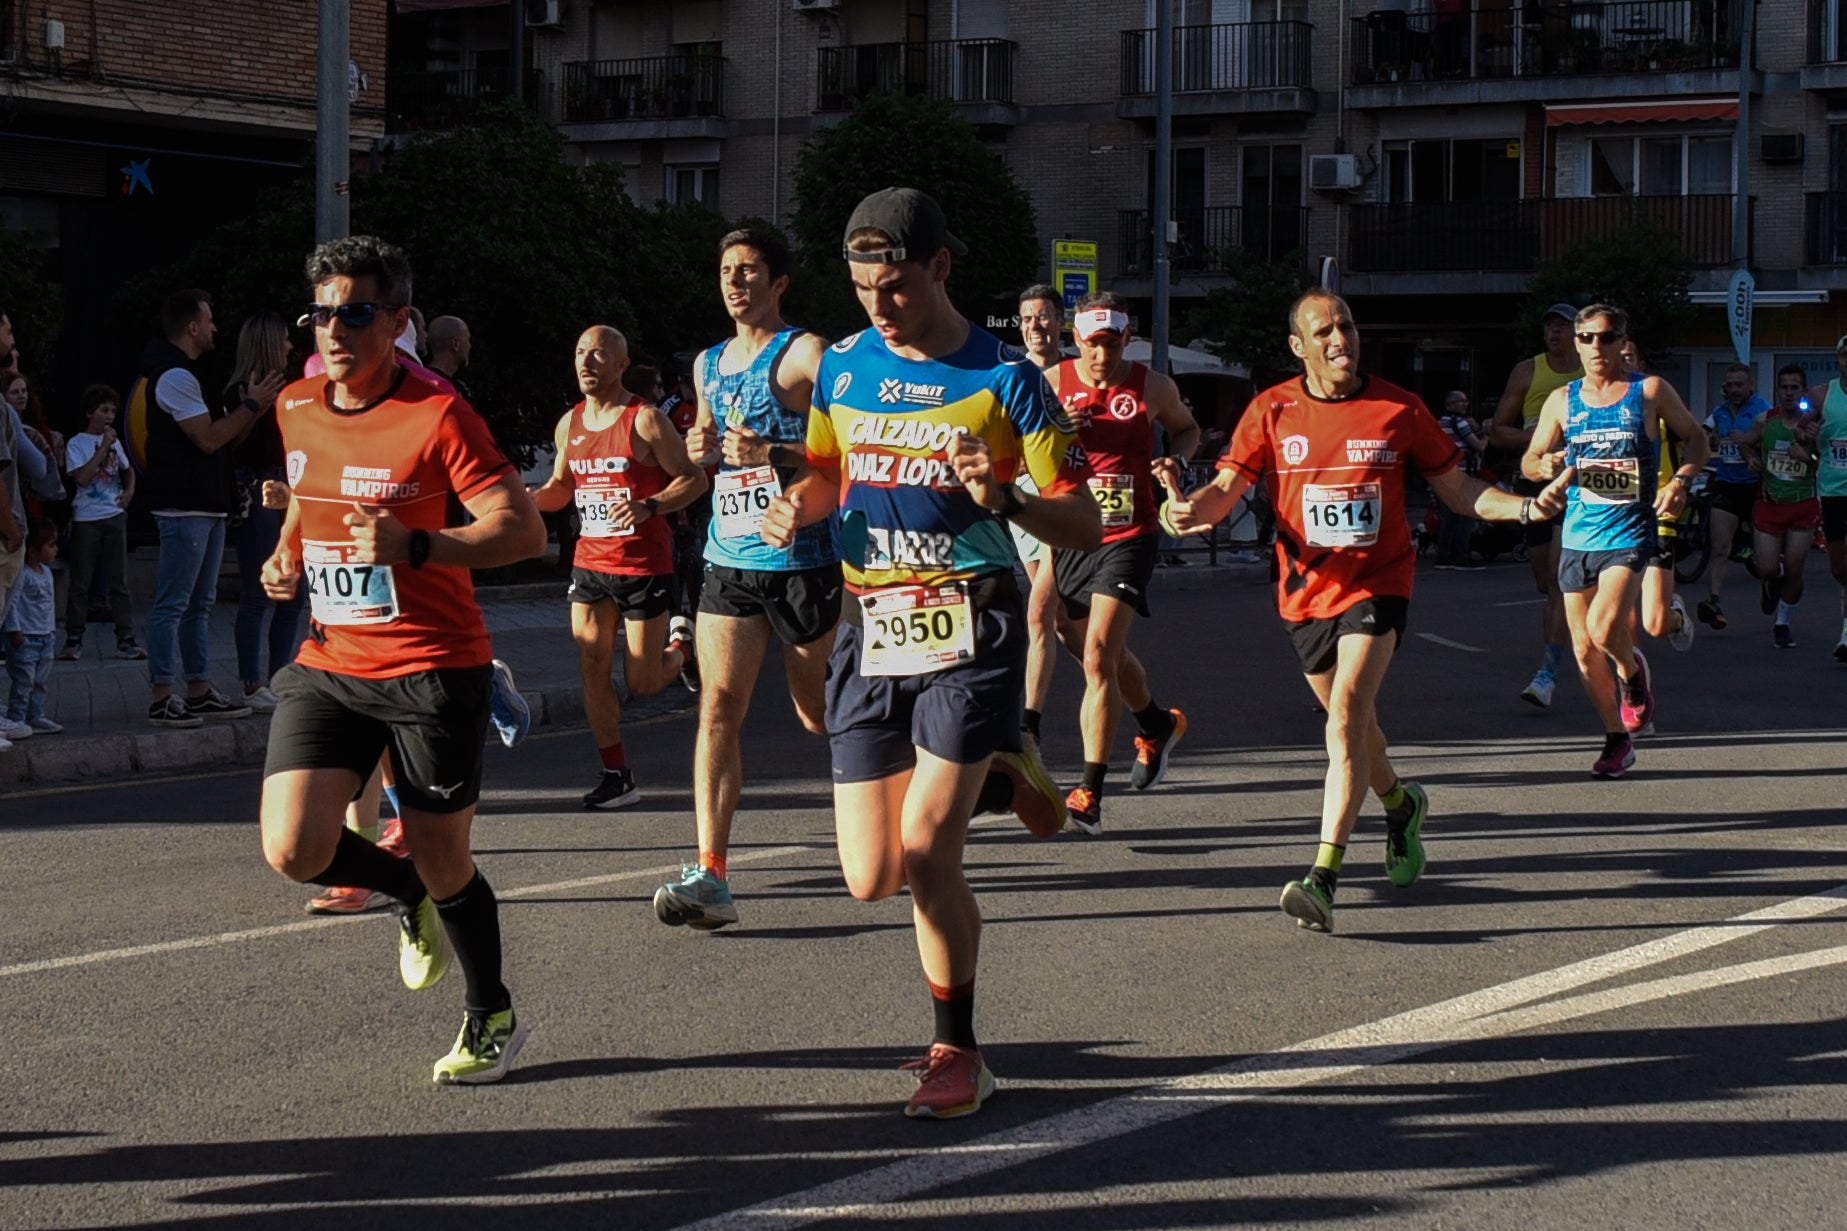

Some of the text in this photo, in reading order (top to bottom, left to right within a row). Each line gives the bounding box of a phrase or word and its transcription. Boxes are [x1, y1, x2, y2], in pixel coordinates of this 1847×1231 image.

[986, 314, 1020, 328] Bar S
[847, 452, 956, 487] DIAZ LOPE
[1769, 460, 1801, 473] 1720
[341, 478, 420, 499] VAMPIROS
[1582, 472, 1629, 489] 2600
[719, 486, 770, 517] 2376
[1095, 490, 1123, 509] 25
[582, 502, 618, 521] 139
[1308, 501, 1374, 527] 1614
[308, 565, 374, 597] 2107
[871, 609, 954, 650] 2950
